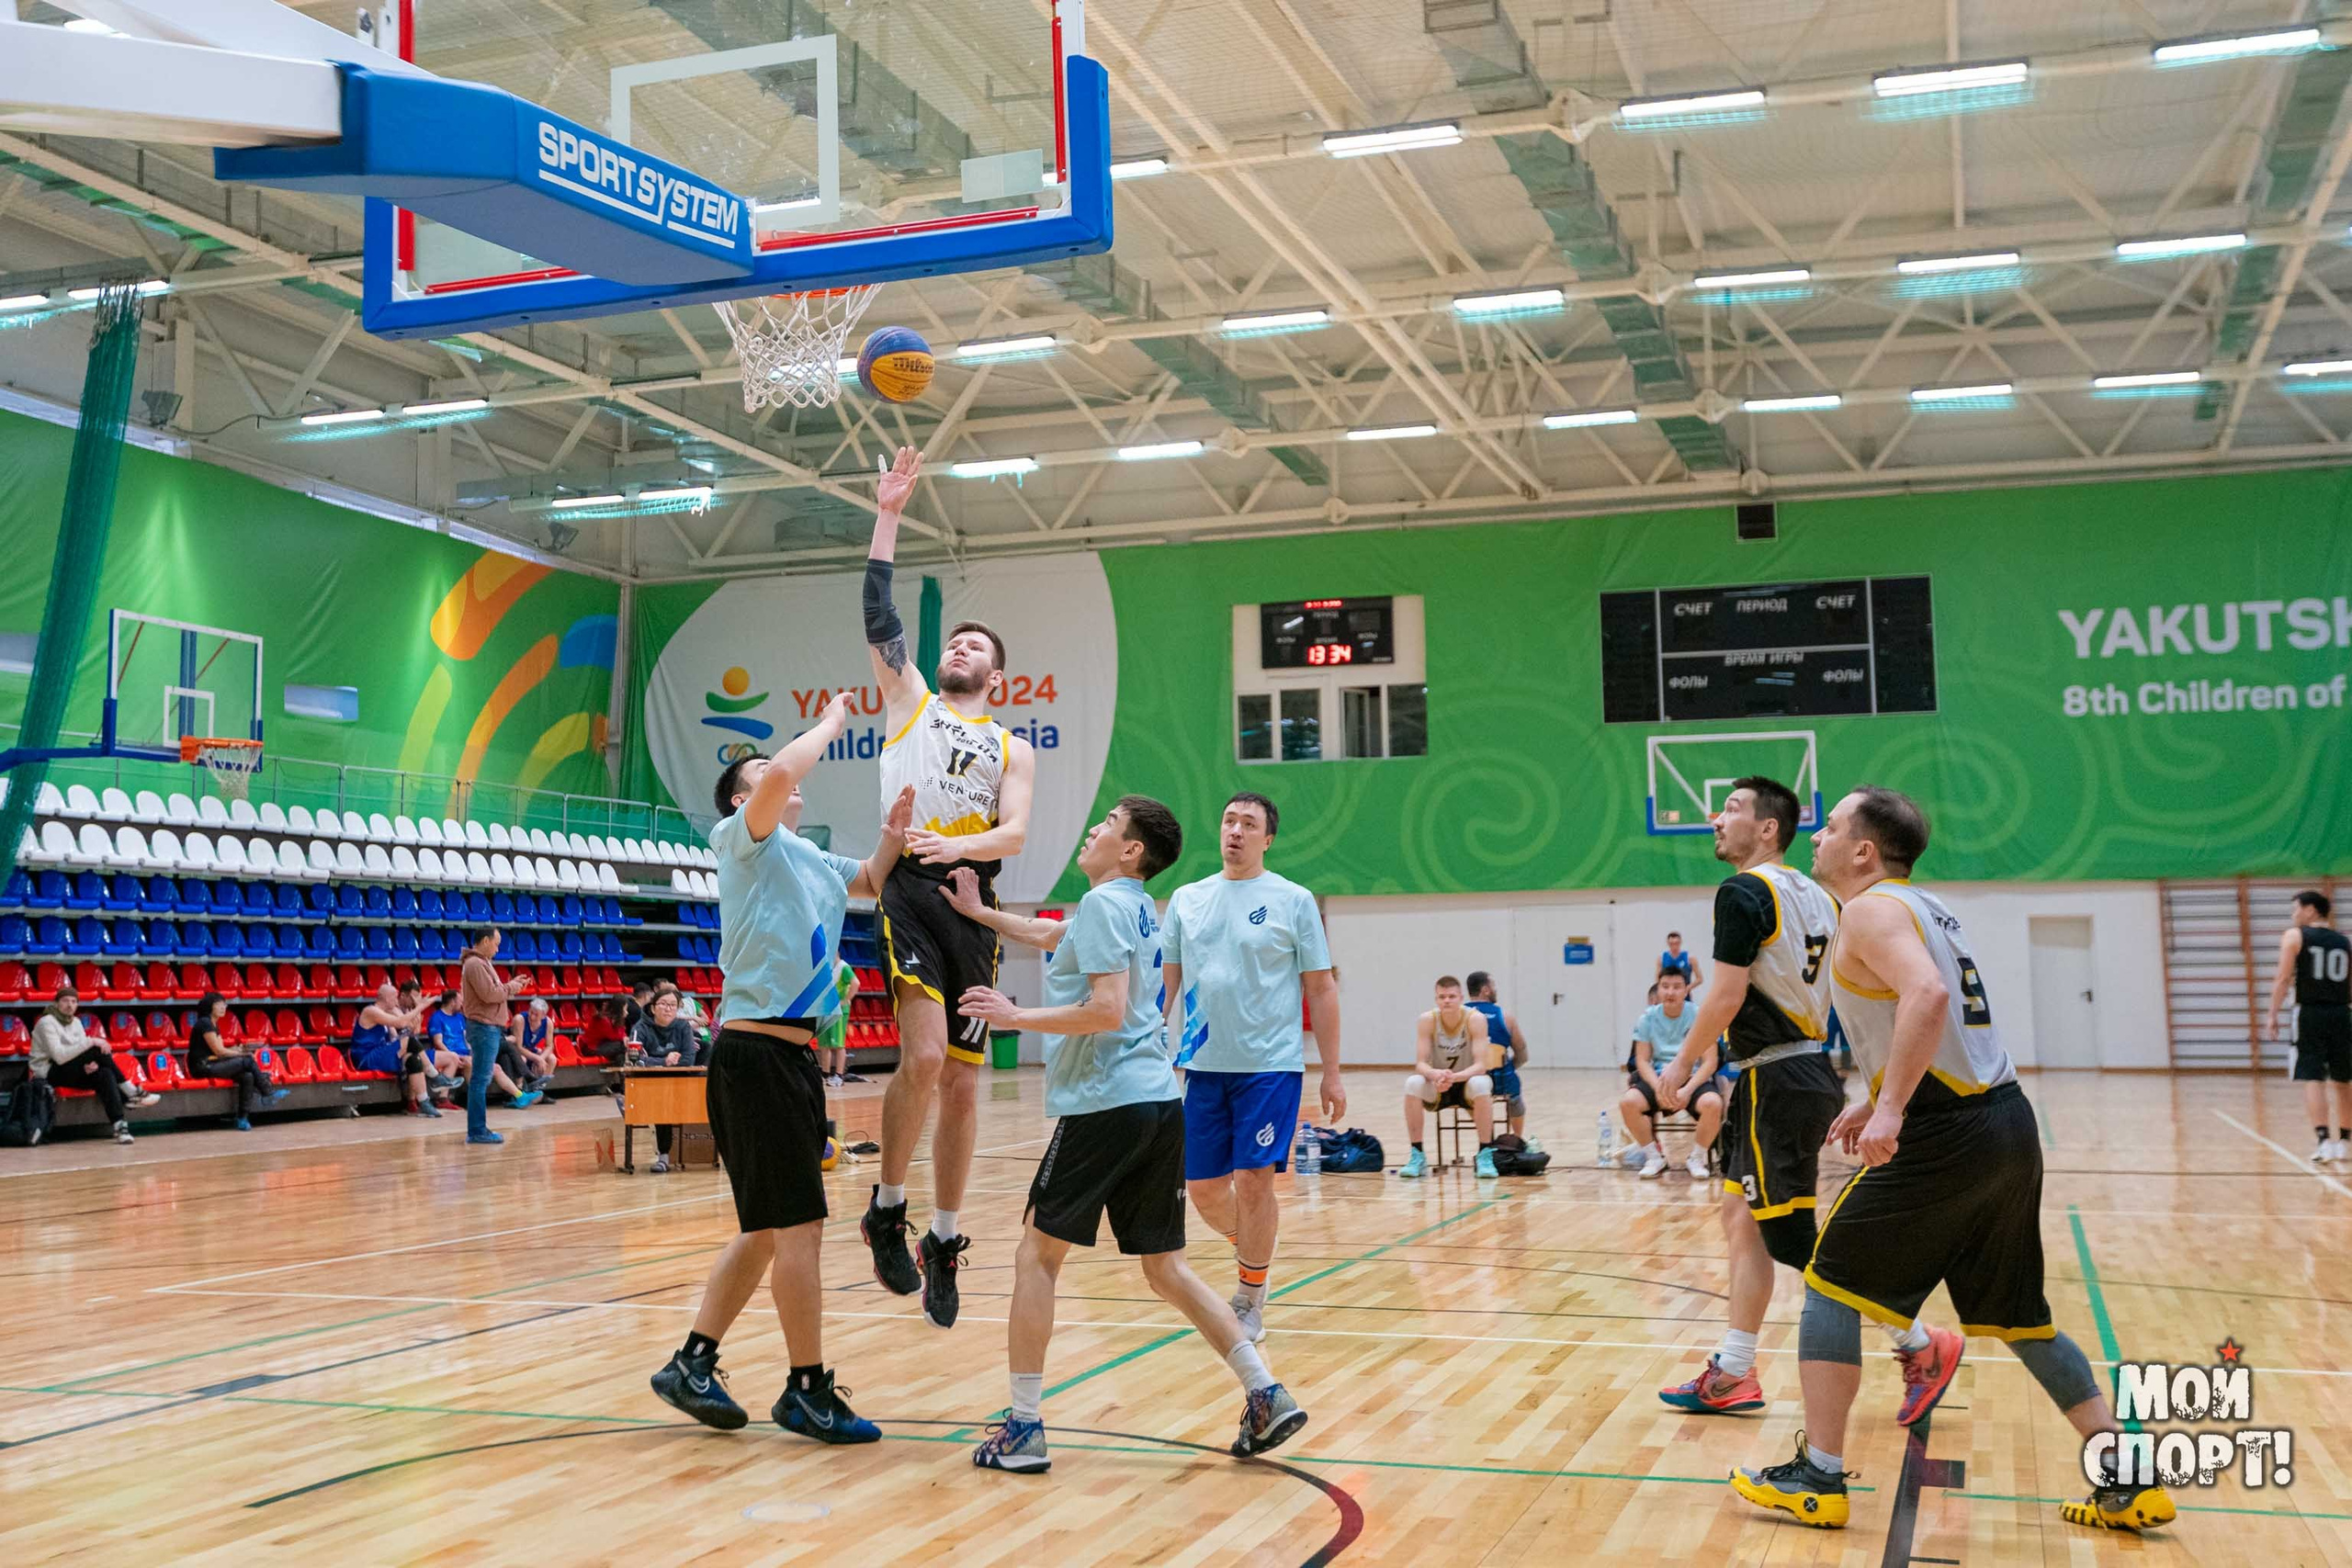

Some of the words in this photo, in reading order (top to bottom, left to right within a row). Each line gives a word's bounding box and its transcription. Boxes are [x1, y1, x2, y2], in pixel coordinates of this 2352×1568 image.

[1674, 602, 1713, 616] СЧЕТ
[1736, 598, 1788, 613] ПЕРИОД
[1815, 595, 1856, 609] СЧЕТ
[1724, 652, 1765, 666] ВРЕМЯ
[1770, 650, 1804, 664] ИГРЫ
[1669, 675, 1709, 689] ФОЛЫ
[1823, 669, 1864, 683] ФОЛЫ
[791, 686, 884, 718] YAKU
[988, 673, 1057, 707] 024
[2064, 683, 2129, 716] 8th
[2139, 679, 2298, 715] Children
[2306, 674, 2346, 708] of
[939, 780, 990, 806] VENURE
[2307, 946, 2349, 983] 10
[1446, 1055, 1460, 1069] 7
[1742, 1174, 1758, 1201] 3
